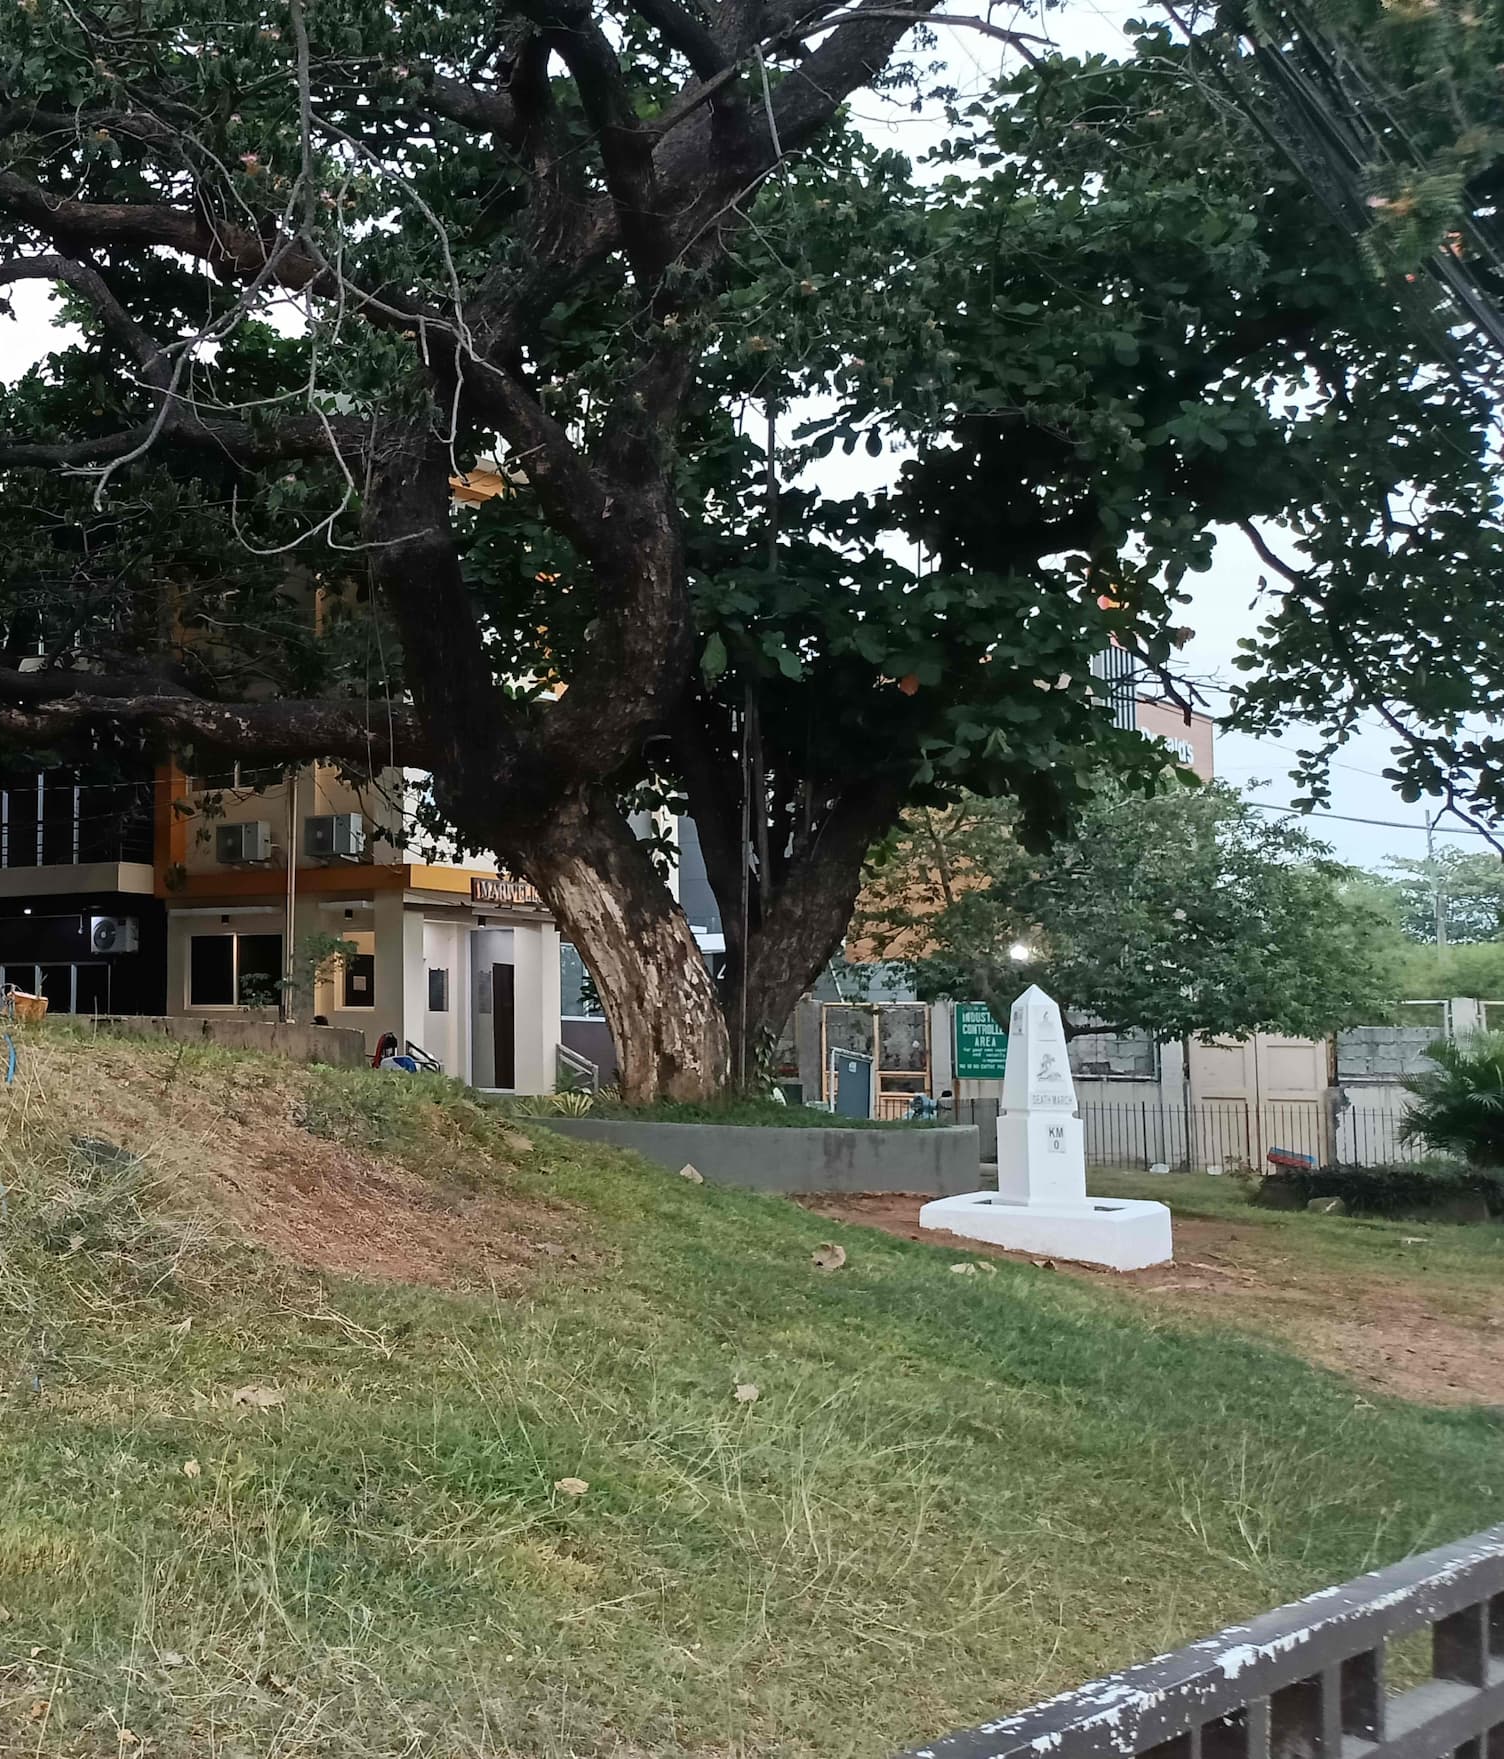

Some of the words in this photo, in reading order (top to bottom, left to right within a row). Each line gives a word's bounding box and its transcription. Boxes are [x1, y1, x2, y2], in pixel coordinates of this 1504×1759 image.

[974, 1036, 997, 1047] AREA
[1048, 1127, 1064, 1138] KM
[1053, 1139, 1060, 1150] 0
